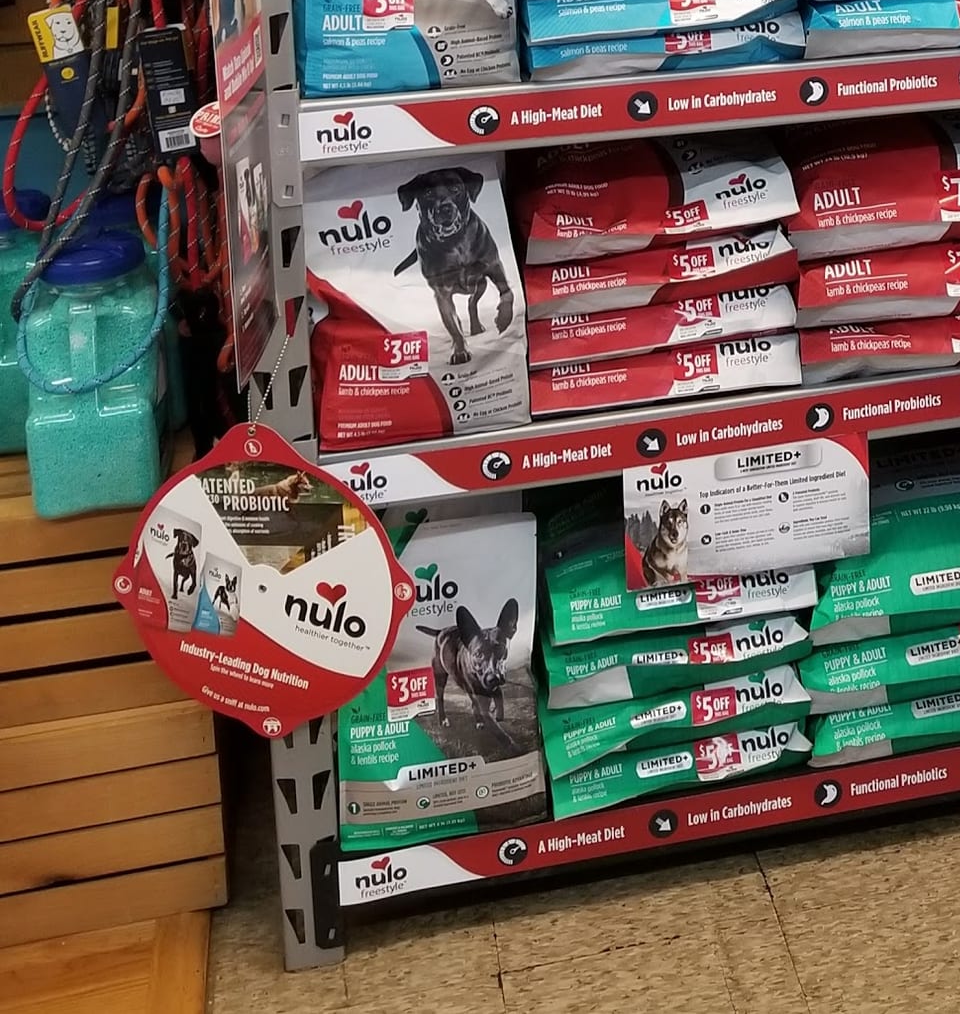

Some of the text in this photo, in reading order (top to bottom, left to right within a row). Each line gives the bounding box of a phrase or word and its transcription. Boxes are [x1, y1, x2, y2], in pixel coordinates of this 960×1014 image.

[323, 14, 362, 31] ADULT
[318, 210, 391, 246] nulo
[339, 386, 409, 397] lamb & chickpeas recipe
[738, 451, 801, 468] LIMITED+
[200, 478, 255, 494] ATENTED
[223, 495, 289, 511] PROBIOTIC
[831, 576, 890, 598] PUPPY & ADULT
[834, 597, 879, 613] alaska pollock
[284, 592, 366, 638] nulo
[295, 625, 328, 642] healthier
[180, 640, 309, 690] Industry-Leading Dog Nutrition
[202, 685, 213, 697] Give
[225, 697, 238, 708] sniff
[245, 702, 269, 712] nulo.com
[408, 762, 477, 782] LIMITED+
[355, 866, 407, 890] nulo
